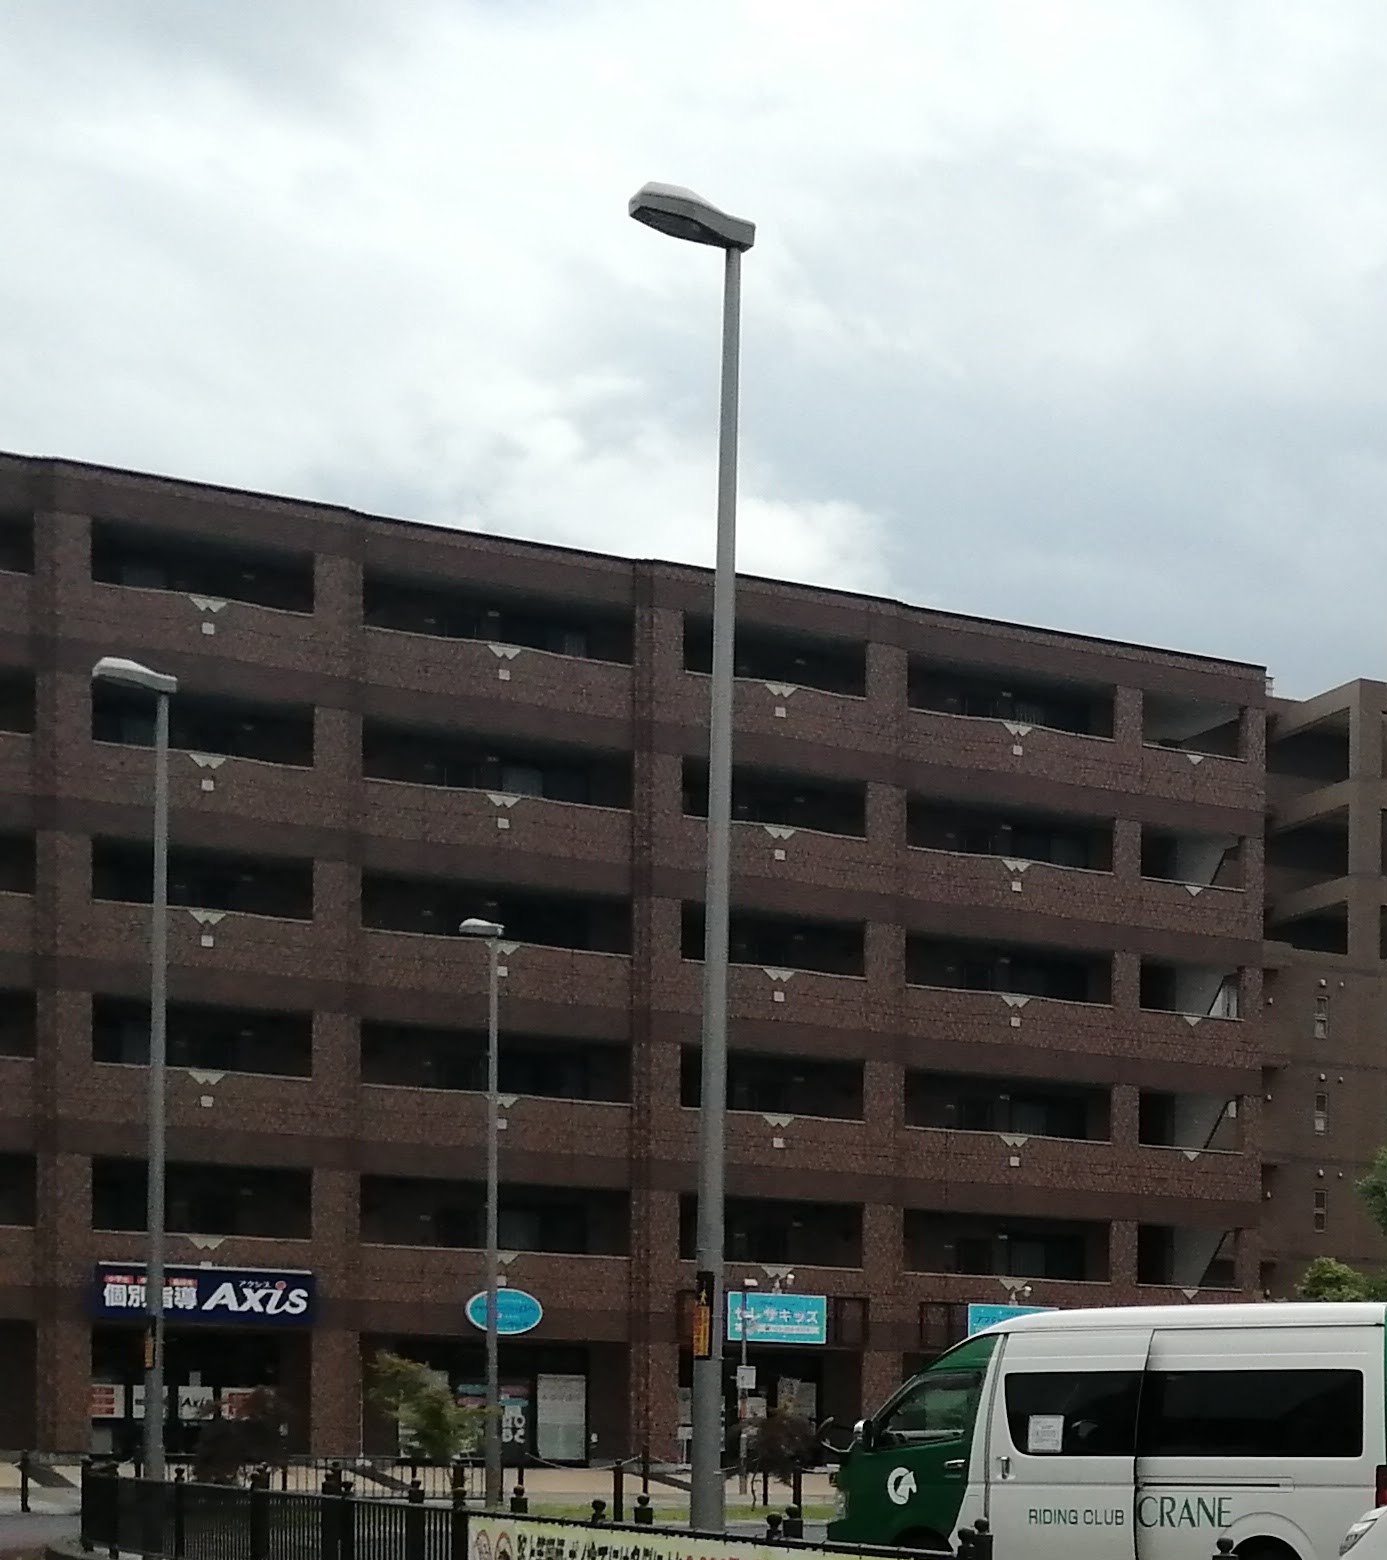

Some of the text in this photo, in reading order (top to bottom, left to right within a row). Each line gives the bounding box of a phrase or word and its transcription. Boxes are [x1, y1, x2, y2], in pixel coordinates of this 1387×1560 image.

[1028, 1495, 1233, 1528] RIDING CLUB CRANE
